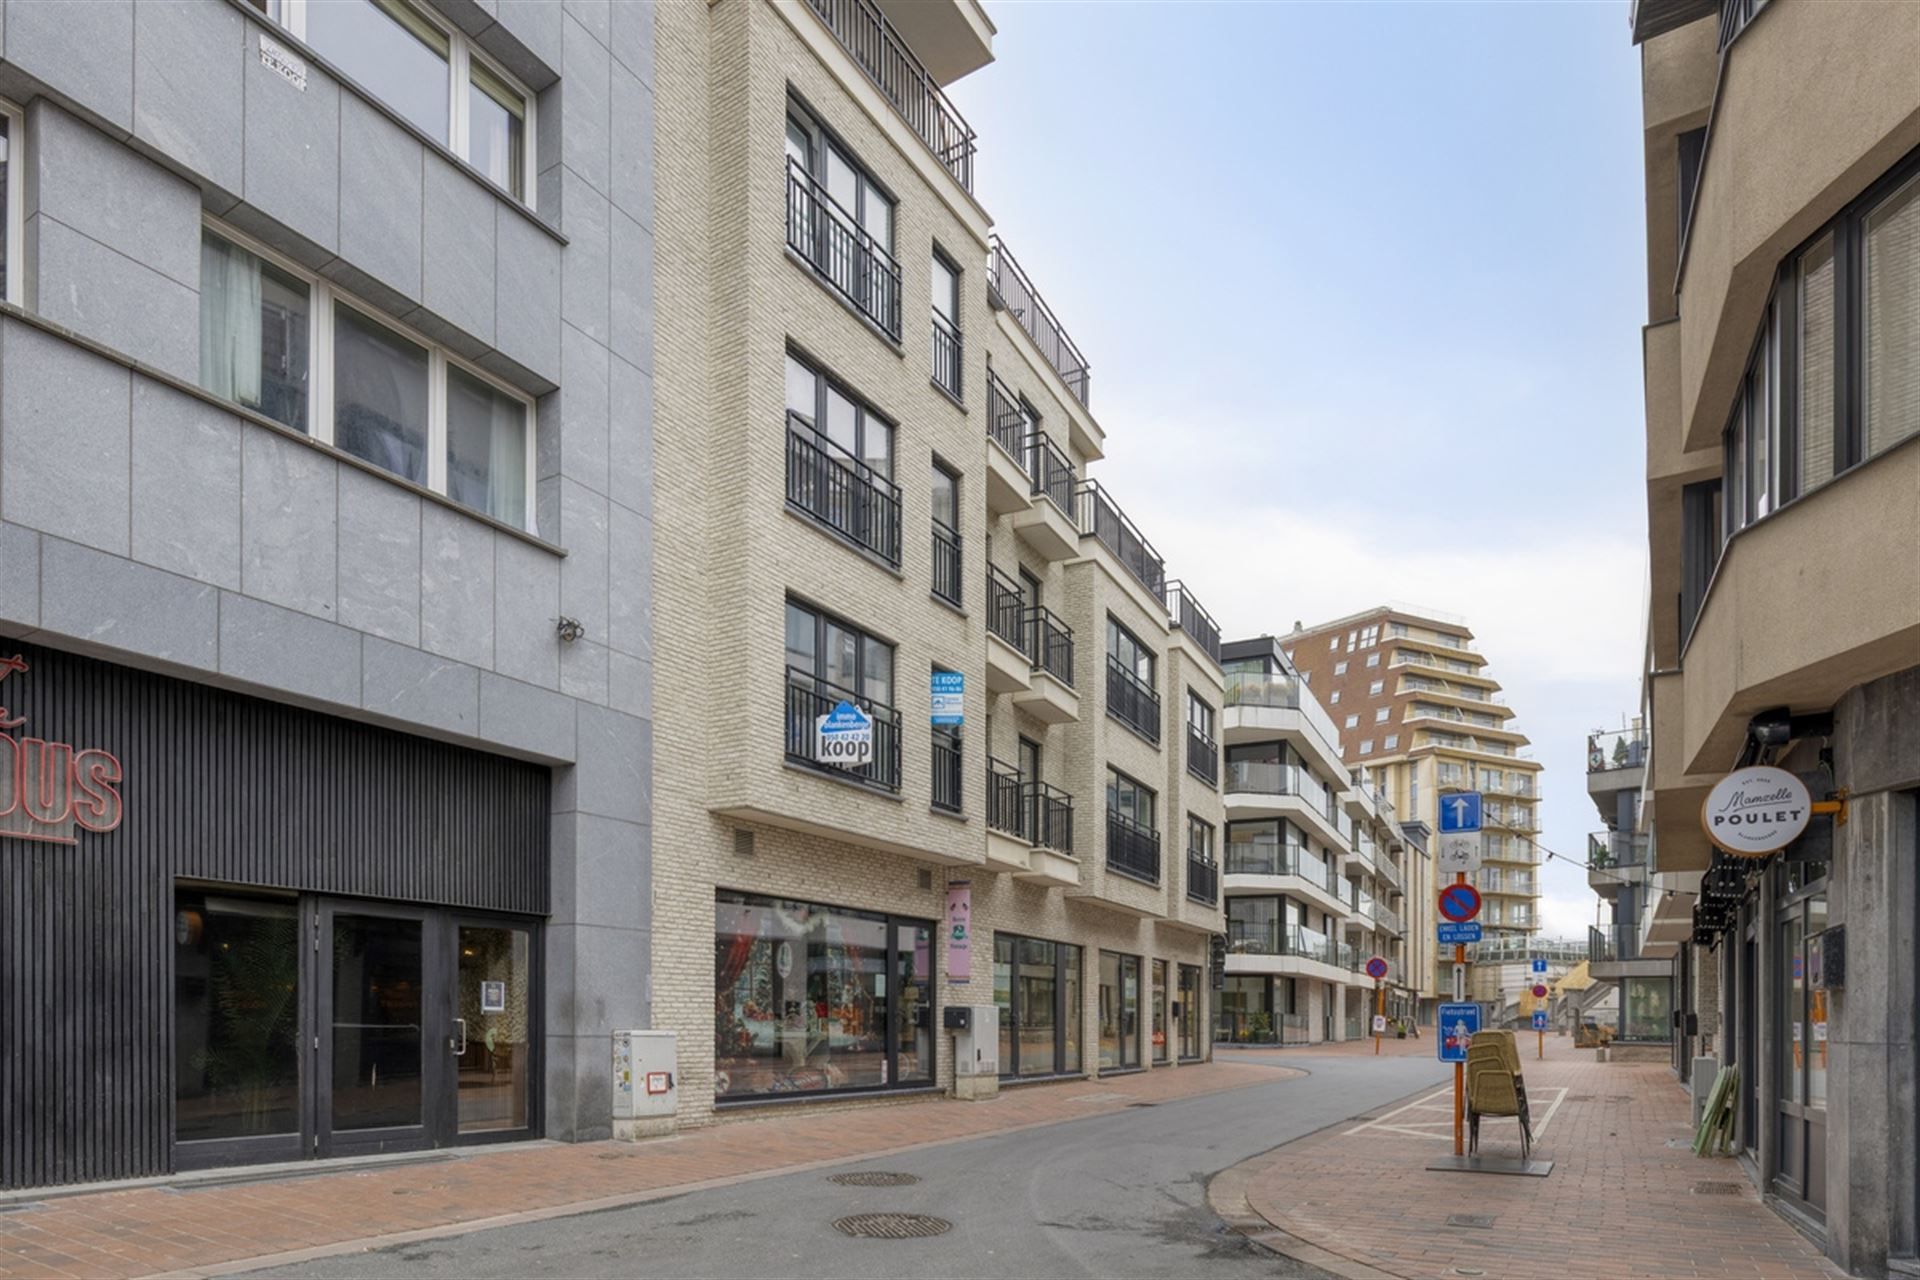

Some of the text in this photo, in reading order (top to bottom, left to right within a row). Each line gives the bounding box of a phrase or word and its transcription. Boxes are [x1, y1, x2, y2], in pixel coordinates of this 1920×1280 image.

[941, 676, 962, 685] KOOP
[821, 735, 870, 762] koop
[1718, 787, 1793, 813] Mamzelle
[1714, 810, 1801, 826] POULET
[1458, 924, 1479, 932] LADEN
[1442, 932, 1476, 941] EN LOSSEN
